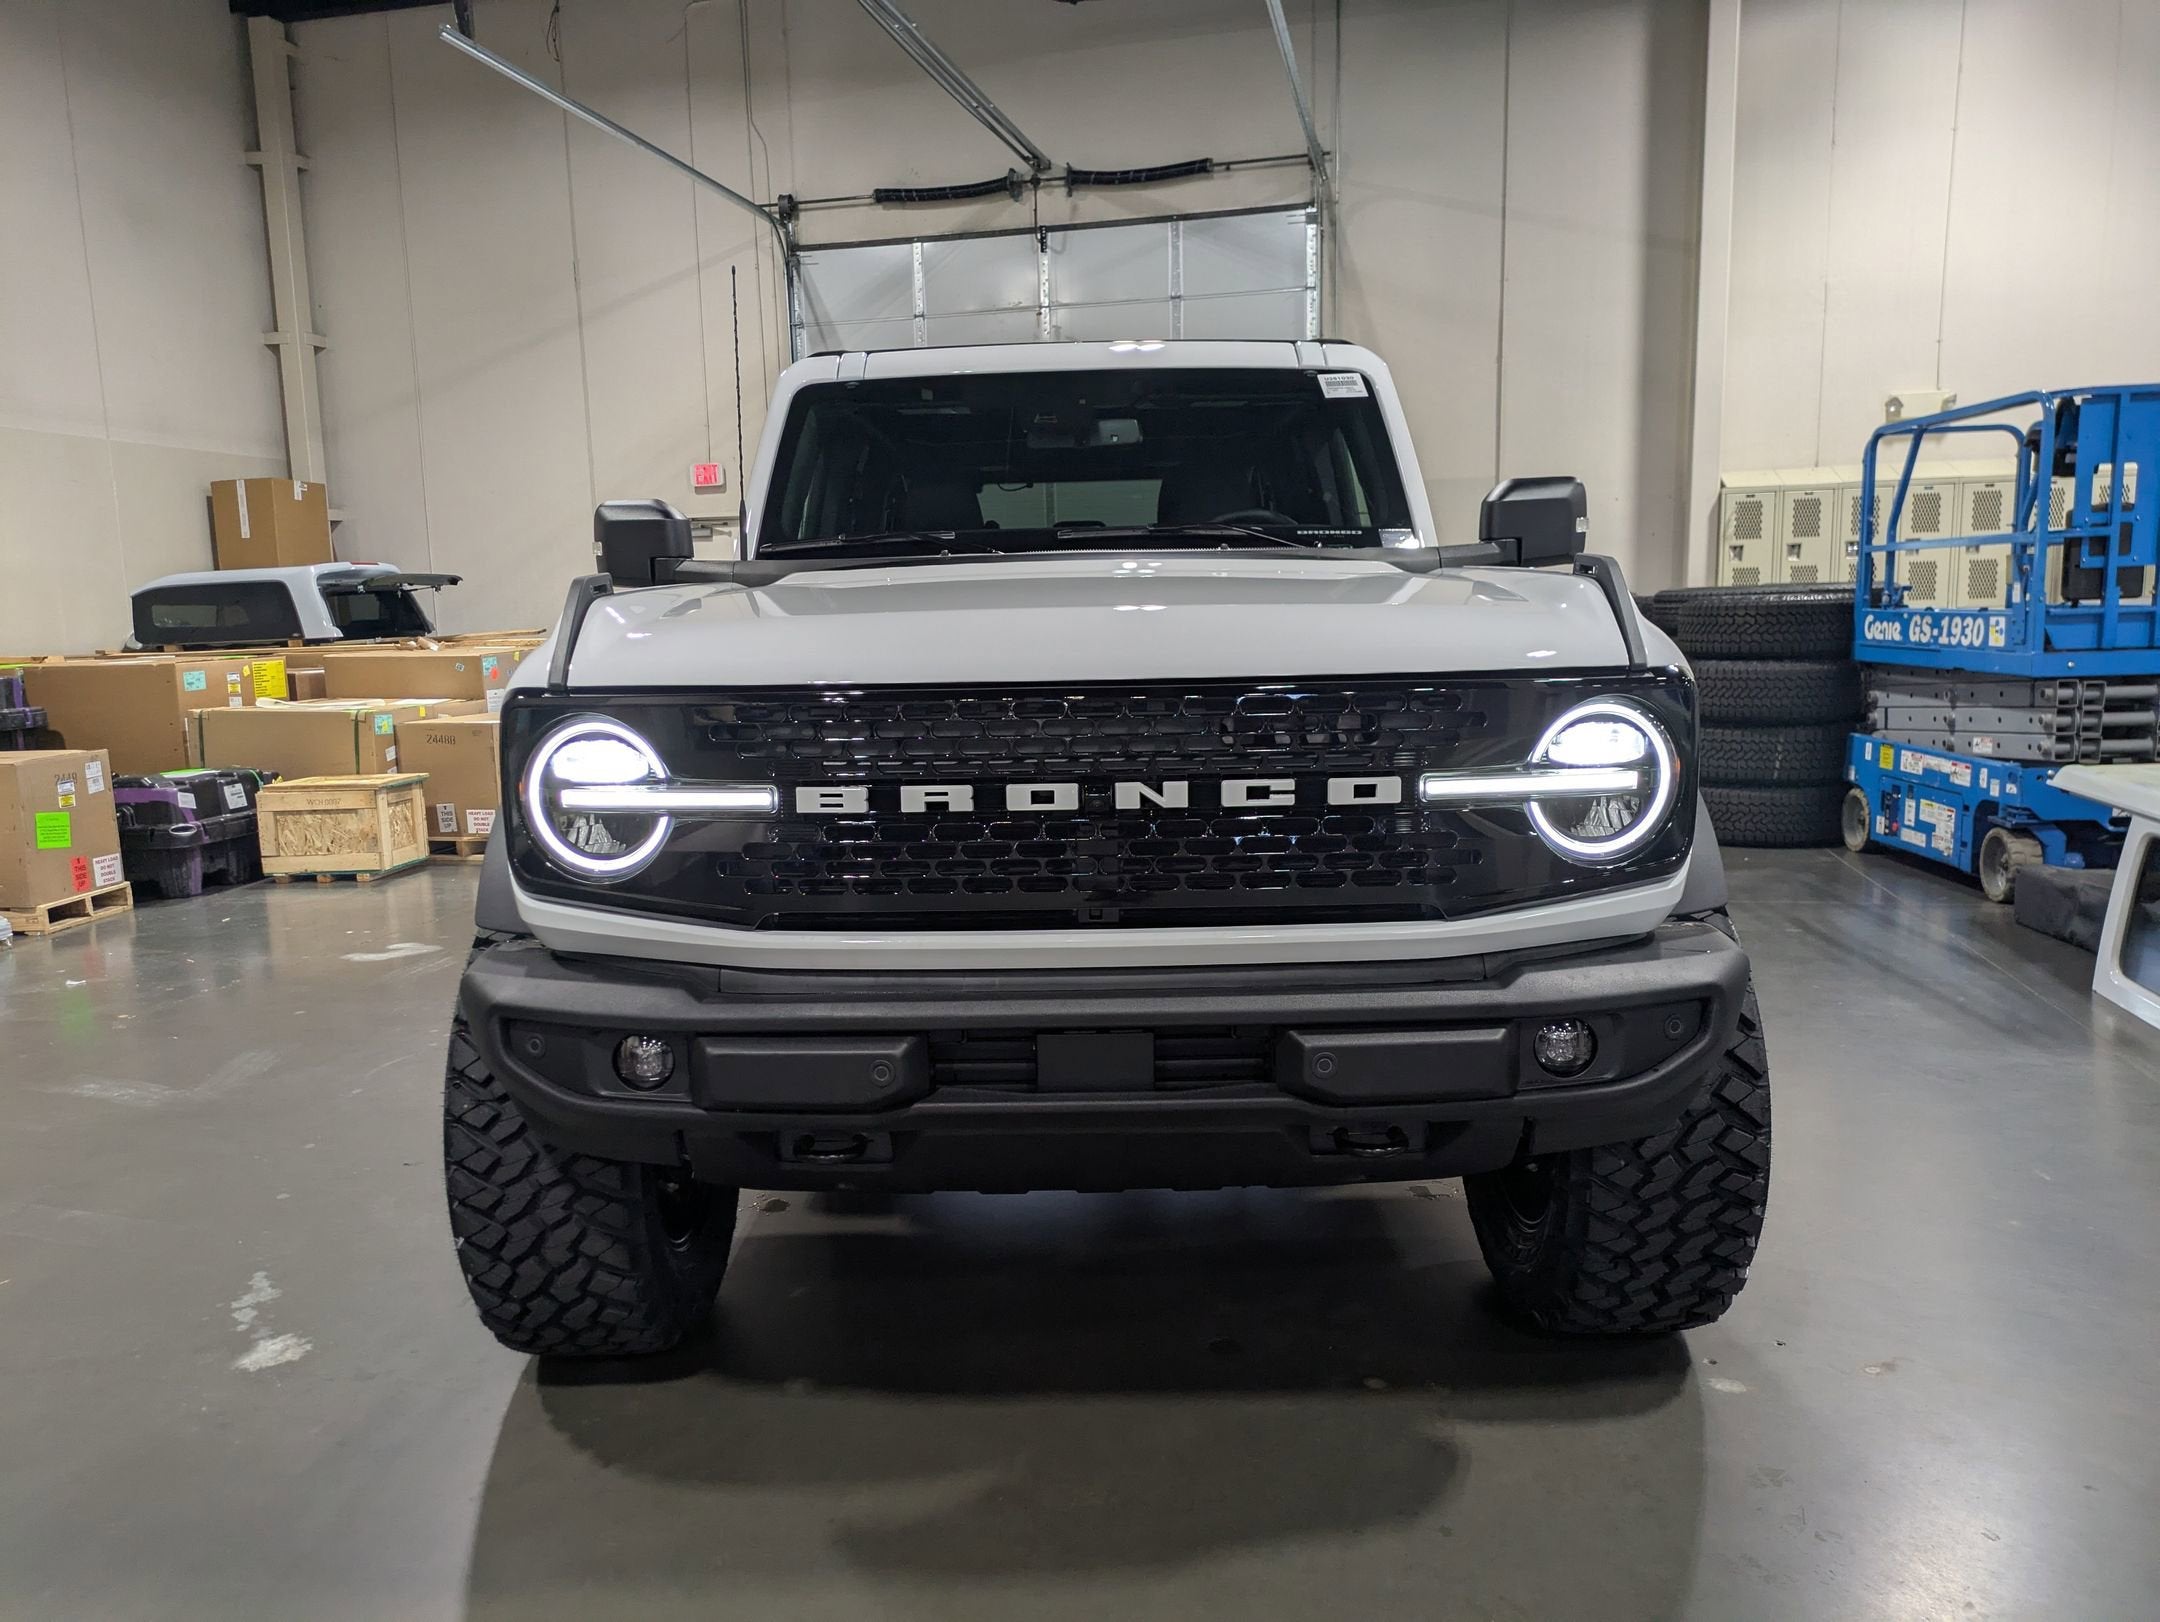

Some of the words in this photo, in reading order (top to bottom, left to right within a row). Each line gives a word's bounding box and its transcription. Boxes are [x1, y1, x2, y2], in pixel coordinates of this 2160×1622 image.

[1864, 614, 1903, 641] Genie
[1908, 614, 1985, 647] GS-1930
[796, 776, 1402, 814] BRONCO
[74, 864, 87, 872] THIS
